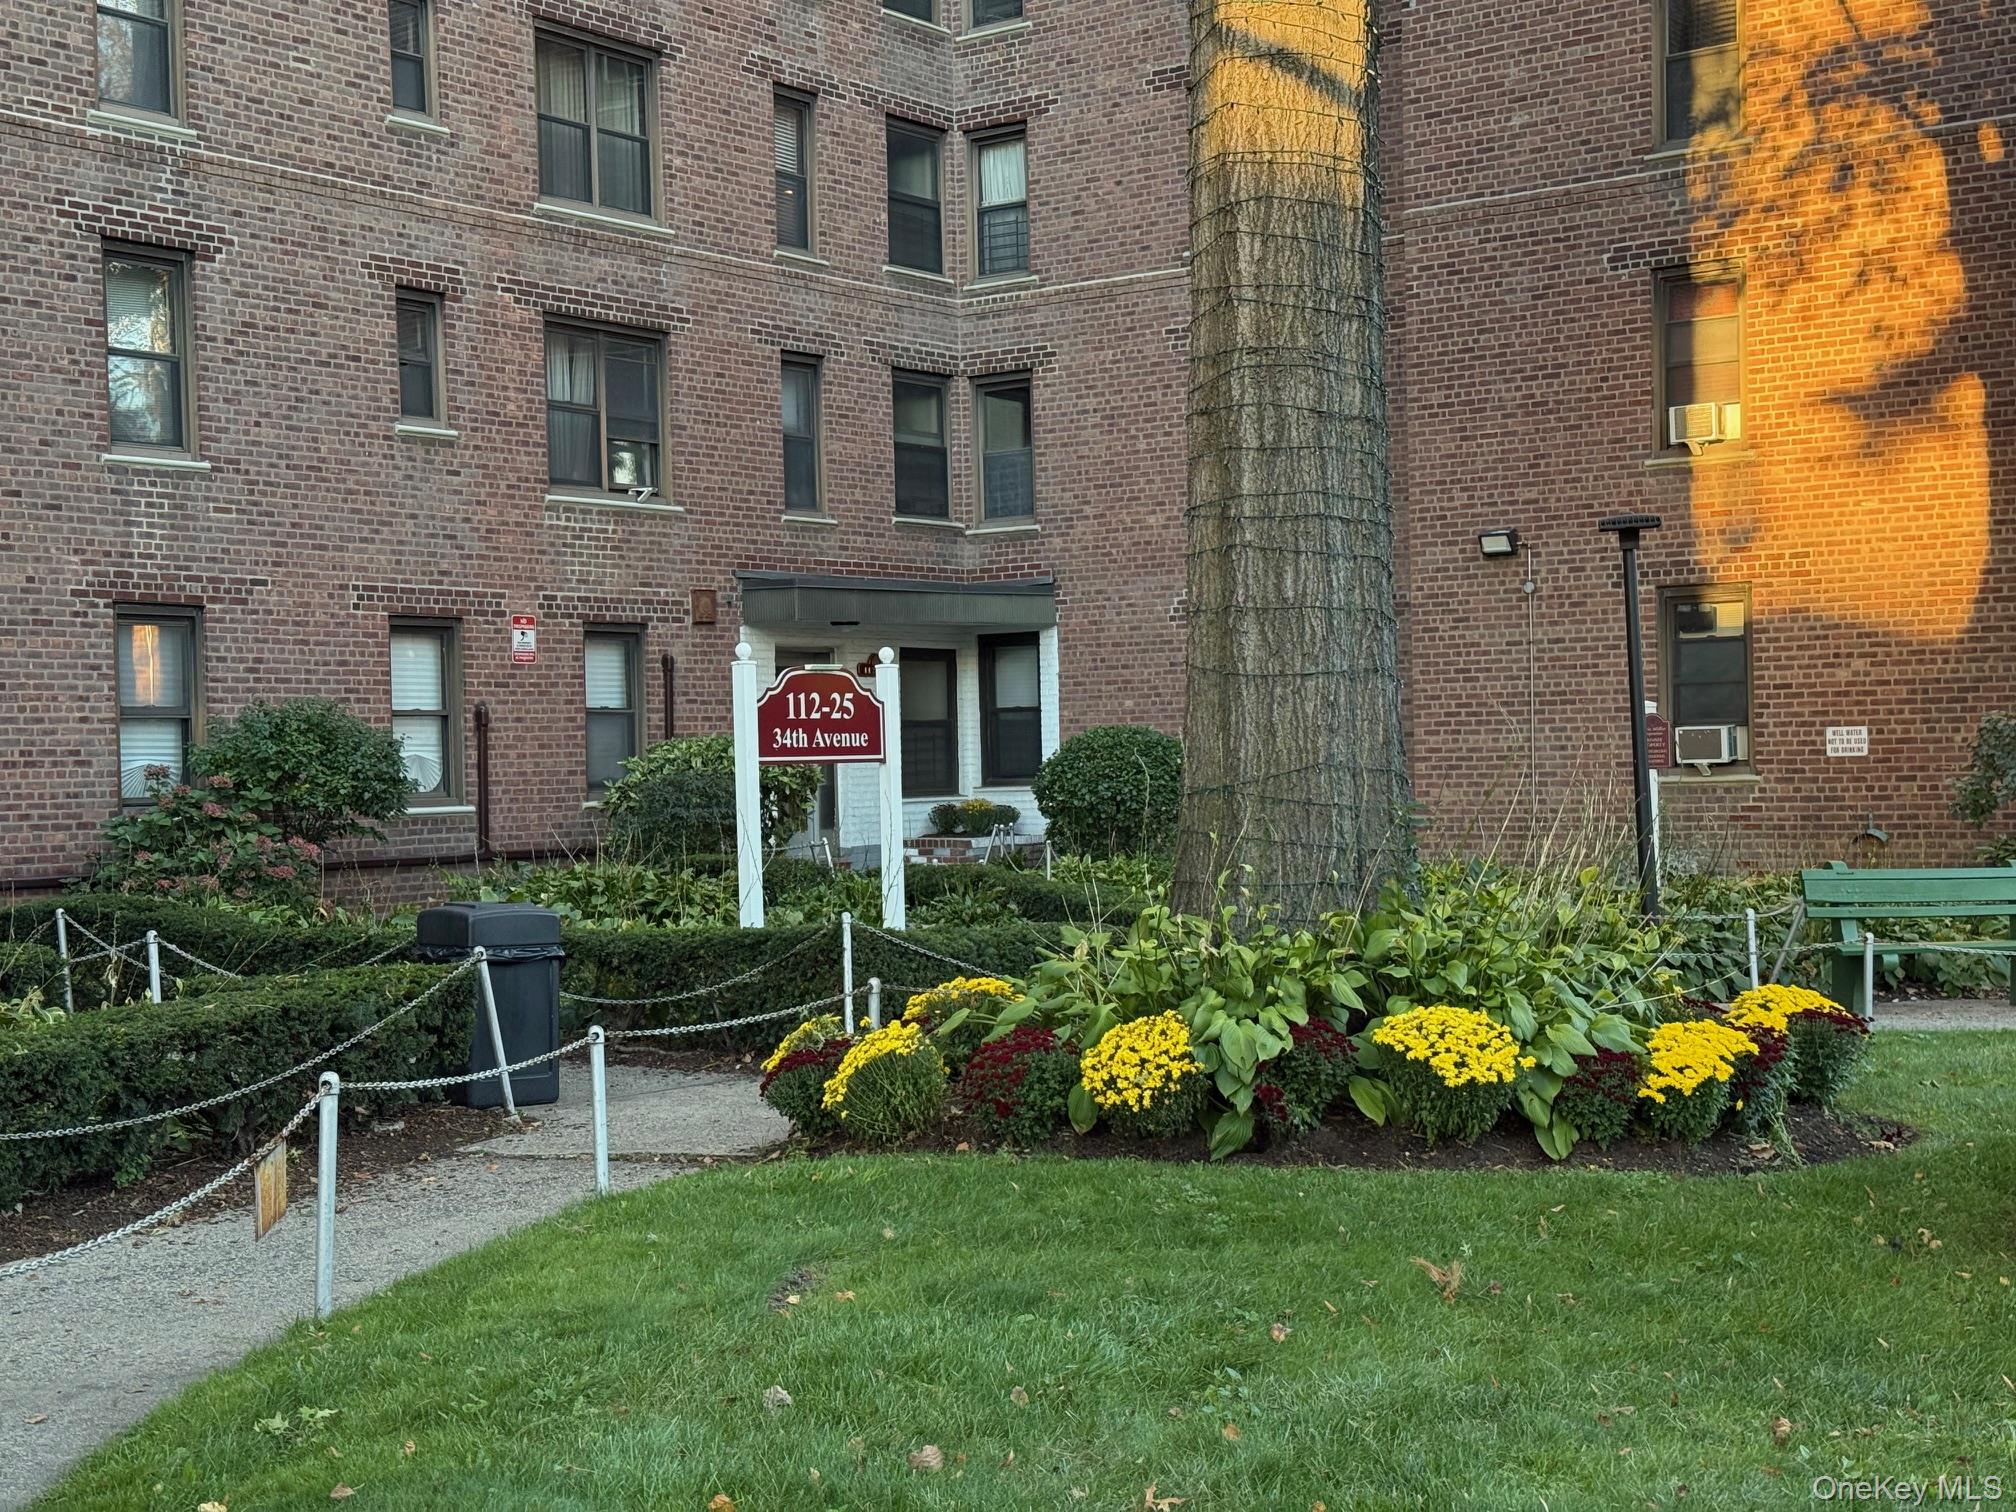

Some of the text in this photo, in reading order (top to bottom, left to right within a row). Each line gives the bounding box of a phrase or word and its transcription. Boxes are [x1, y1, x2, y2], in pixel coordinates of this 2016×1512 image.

[786, 692, 855, 719] 112-25
[772, 727, 869, 748] 34th Avenue
